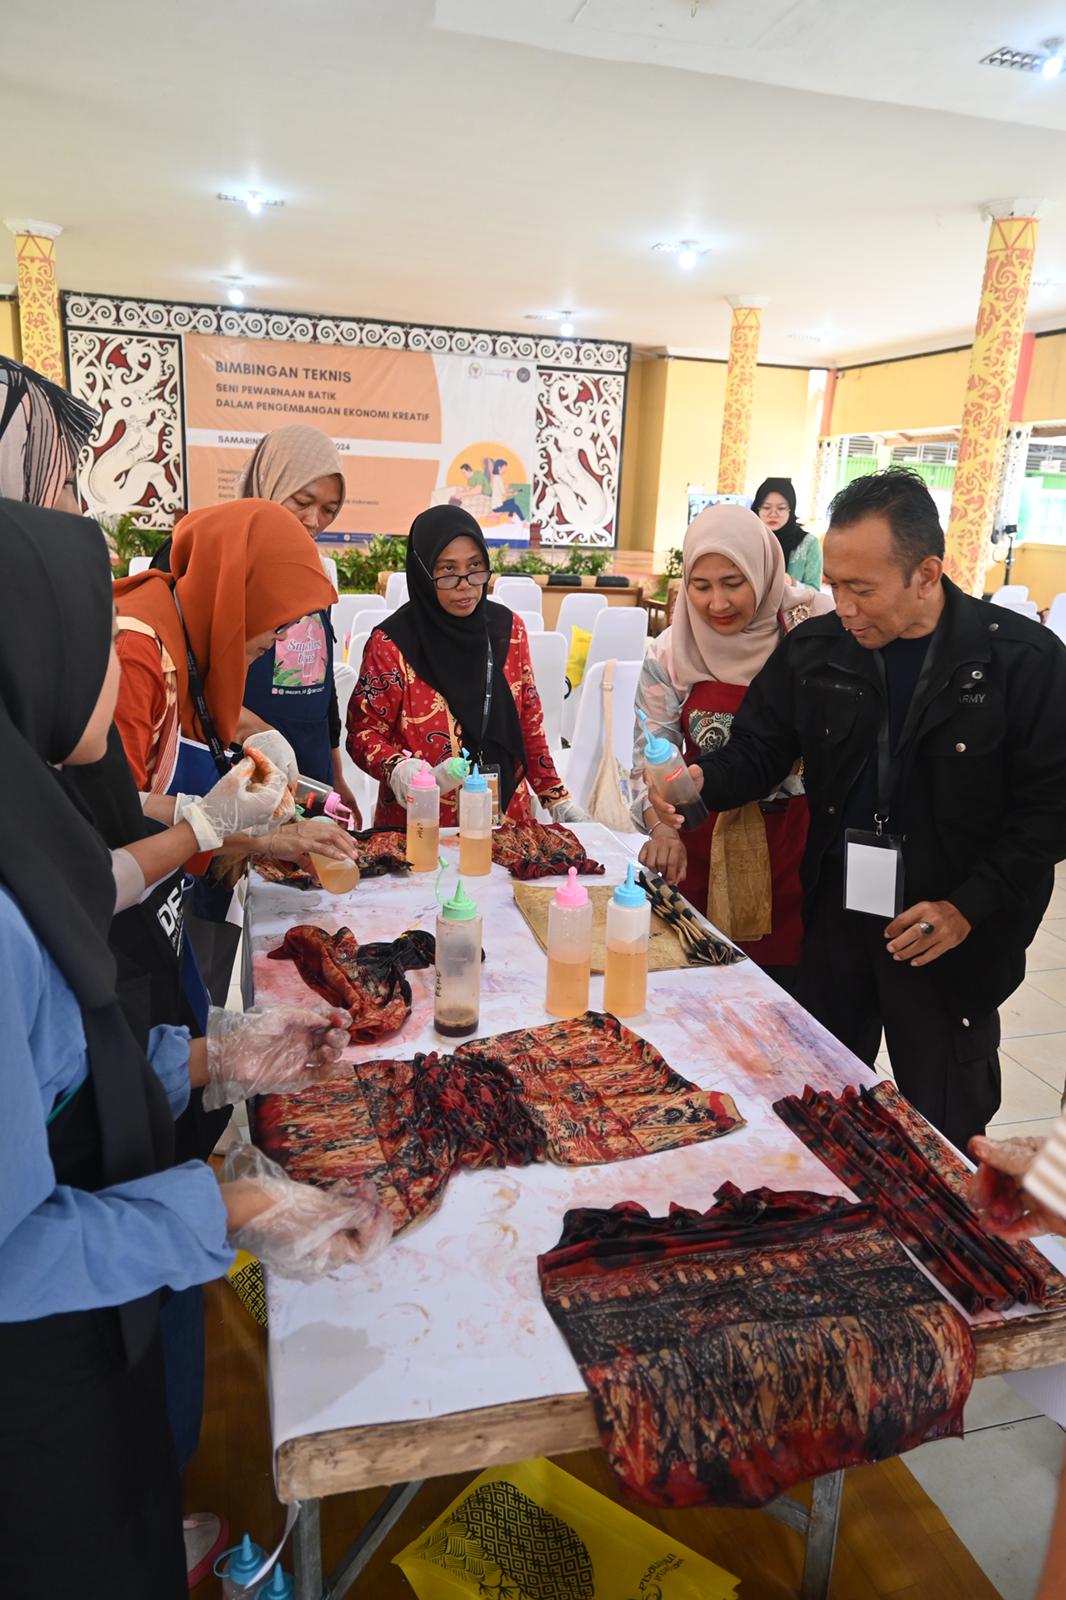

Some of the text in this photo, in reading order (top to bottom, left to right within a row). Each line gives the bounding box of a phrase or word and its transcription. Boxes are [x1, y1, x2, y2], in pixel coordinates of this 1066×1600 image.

[215, 361, 351, 383] BIMBINGAN TEKNIS
[216, 383, 336, 400] SENI PEWARNAAN BATIK
[216, 398, 430, 422] DALAM PENGEMBANGAN EKONOMI KREATIF
